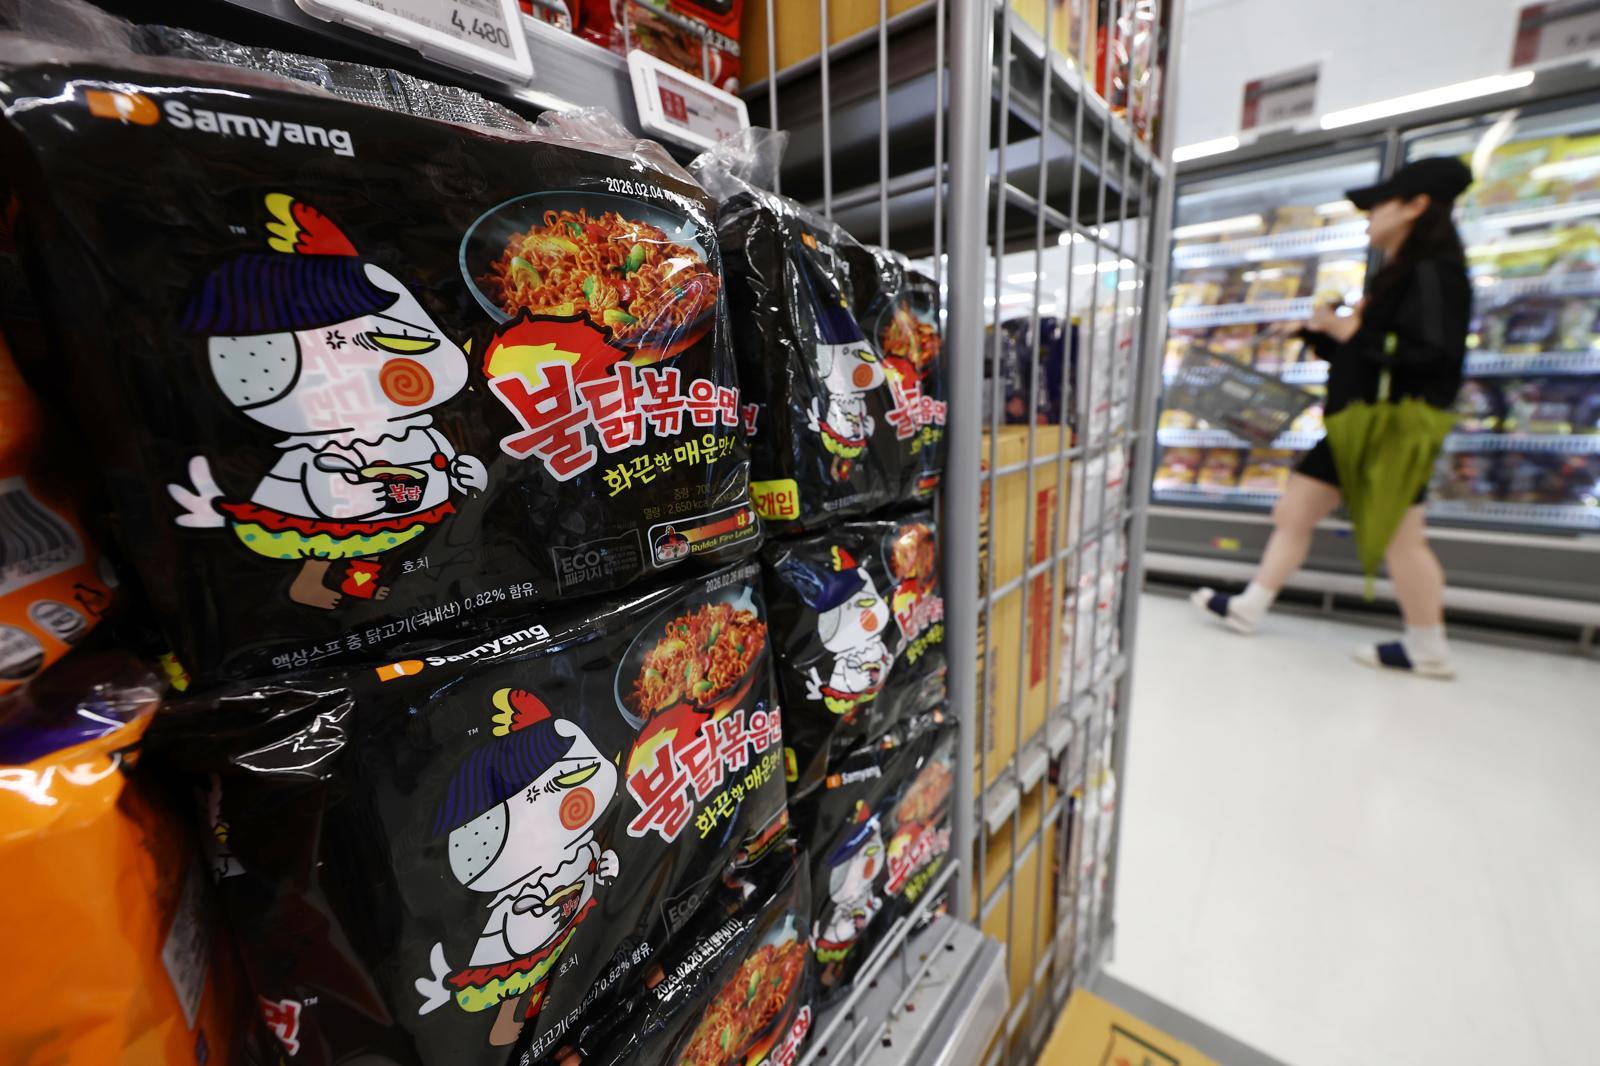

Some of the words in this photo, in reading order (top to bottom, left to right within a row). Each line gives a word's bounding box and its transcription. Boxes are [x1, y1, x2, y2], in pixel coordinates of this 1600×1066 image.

[163, 100, 355, 157] Samyang
[606, 177, 664, 199] 2026.02.04
[488, 360, 739, 482] 불닭볶음면
[602, 452, 673, 498] 화끈한
[673, 433, 736, 466] 매운맛!
[388, 484, 422, 504] 불닭
[751, 485, 795, 518] 개입
[402, 556, 429, 574] 호치
[561, 550, 600, 573] ECO
[565, 565, 602, 586] 패키지
[271, 639, 342, 669] 액상스프
[346, 633, 362, 651] 중
[366, 600, 461, 645] 닭고기(국내산)
[464, 588, 506, 611] 0.82%
[509, 581, 539, 599] 함유.
[426, 623, 550, 667] Samyang
[626, 705, 783, 844] 불닭볶음면
[694, 783, 745, 840] 화끈한
[668, 894, 699, 924] ECO
[600, 960, 630, 991] 0.82%
[632, 942, 654, 964] 함유.
[652, 951, 703, 1000] 2026.02.26
